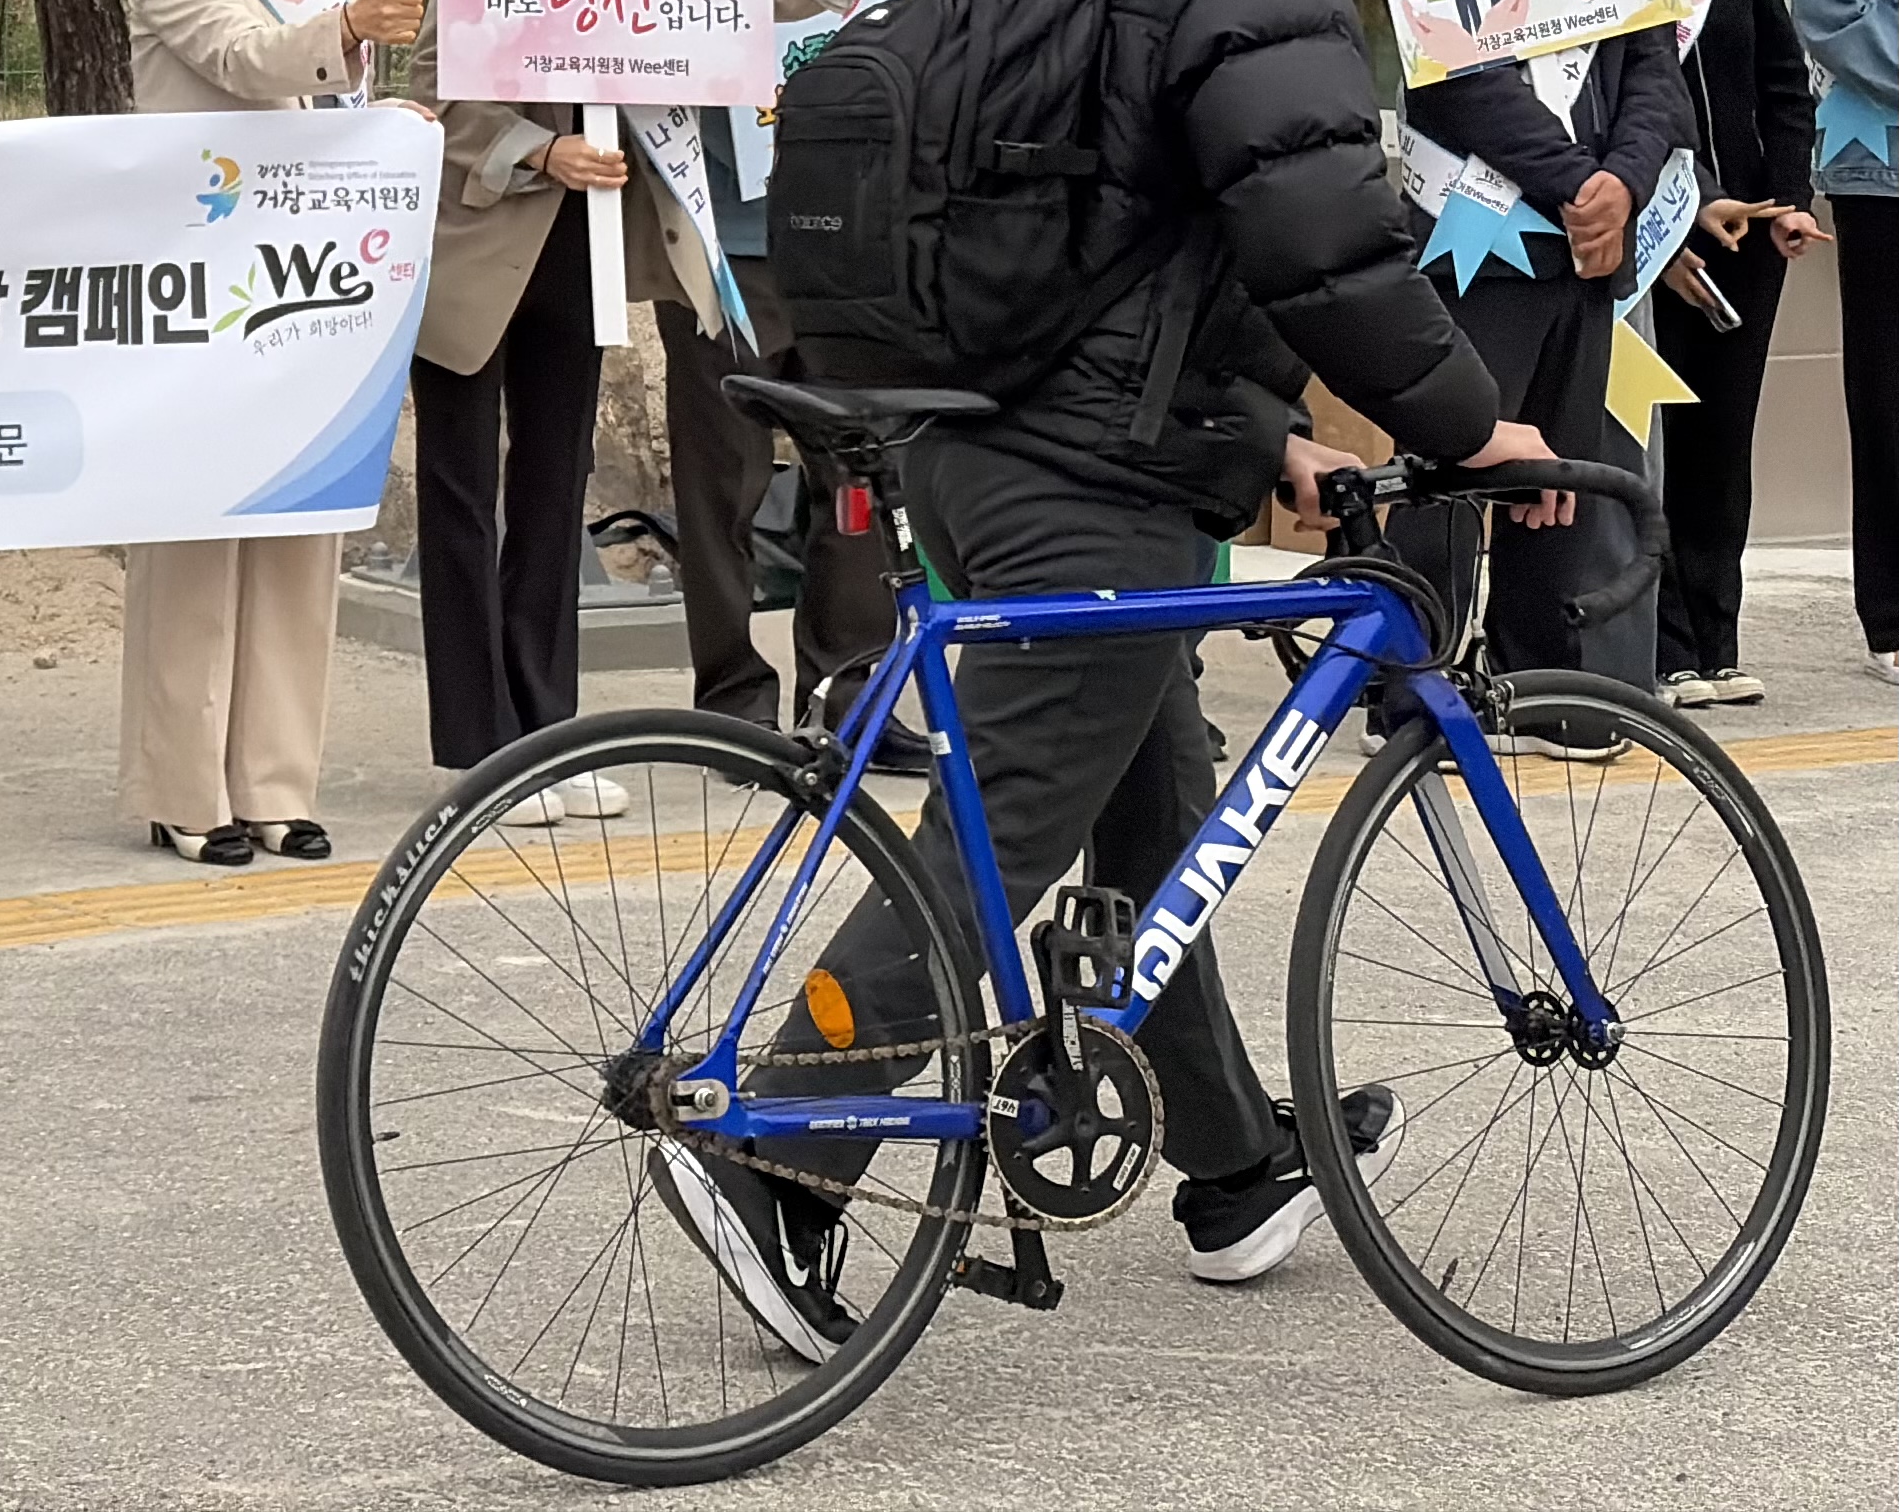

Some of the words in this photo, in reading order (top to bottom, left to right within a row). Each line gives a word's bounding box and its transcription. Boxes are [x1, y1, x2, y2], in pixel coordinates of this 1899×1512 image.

[1476, 19, 1563, 53] 거창교육지원청
[1563, 4, 1620, 33] Wee센터
[523, 54, 625, 76] 거창교육지원청
[628, 56, 690, 76] Wee센터
[644, 124, 707, 214] 나누고
[253, 179, 420, 216] 거창교육지원청
[390, 262, 415, 282] 센터
[19, 261, 210, 349] 캠페인
[252, 322, 301, 357] 우리가
[308, 311, 374, 337] 희망이다!
[1131, 708, 1329, 1002] QUAKE
